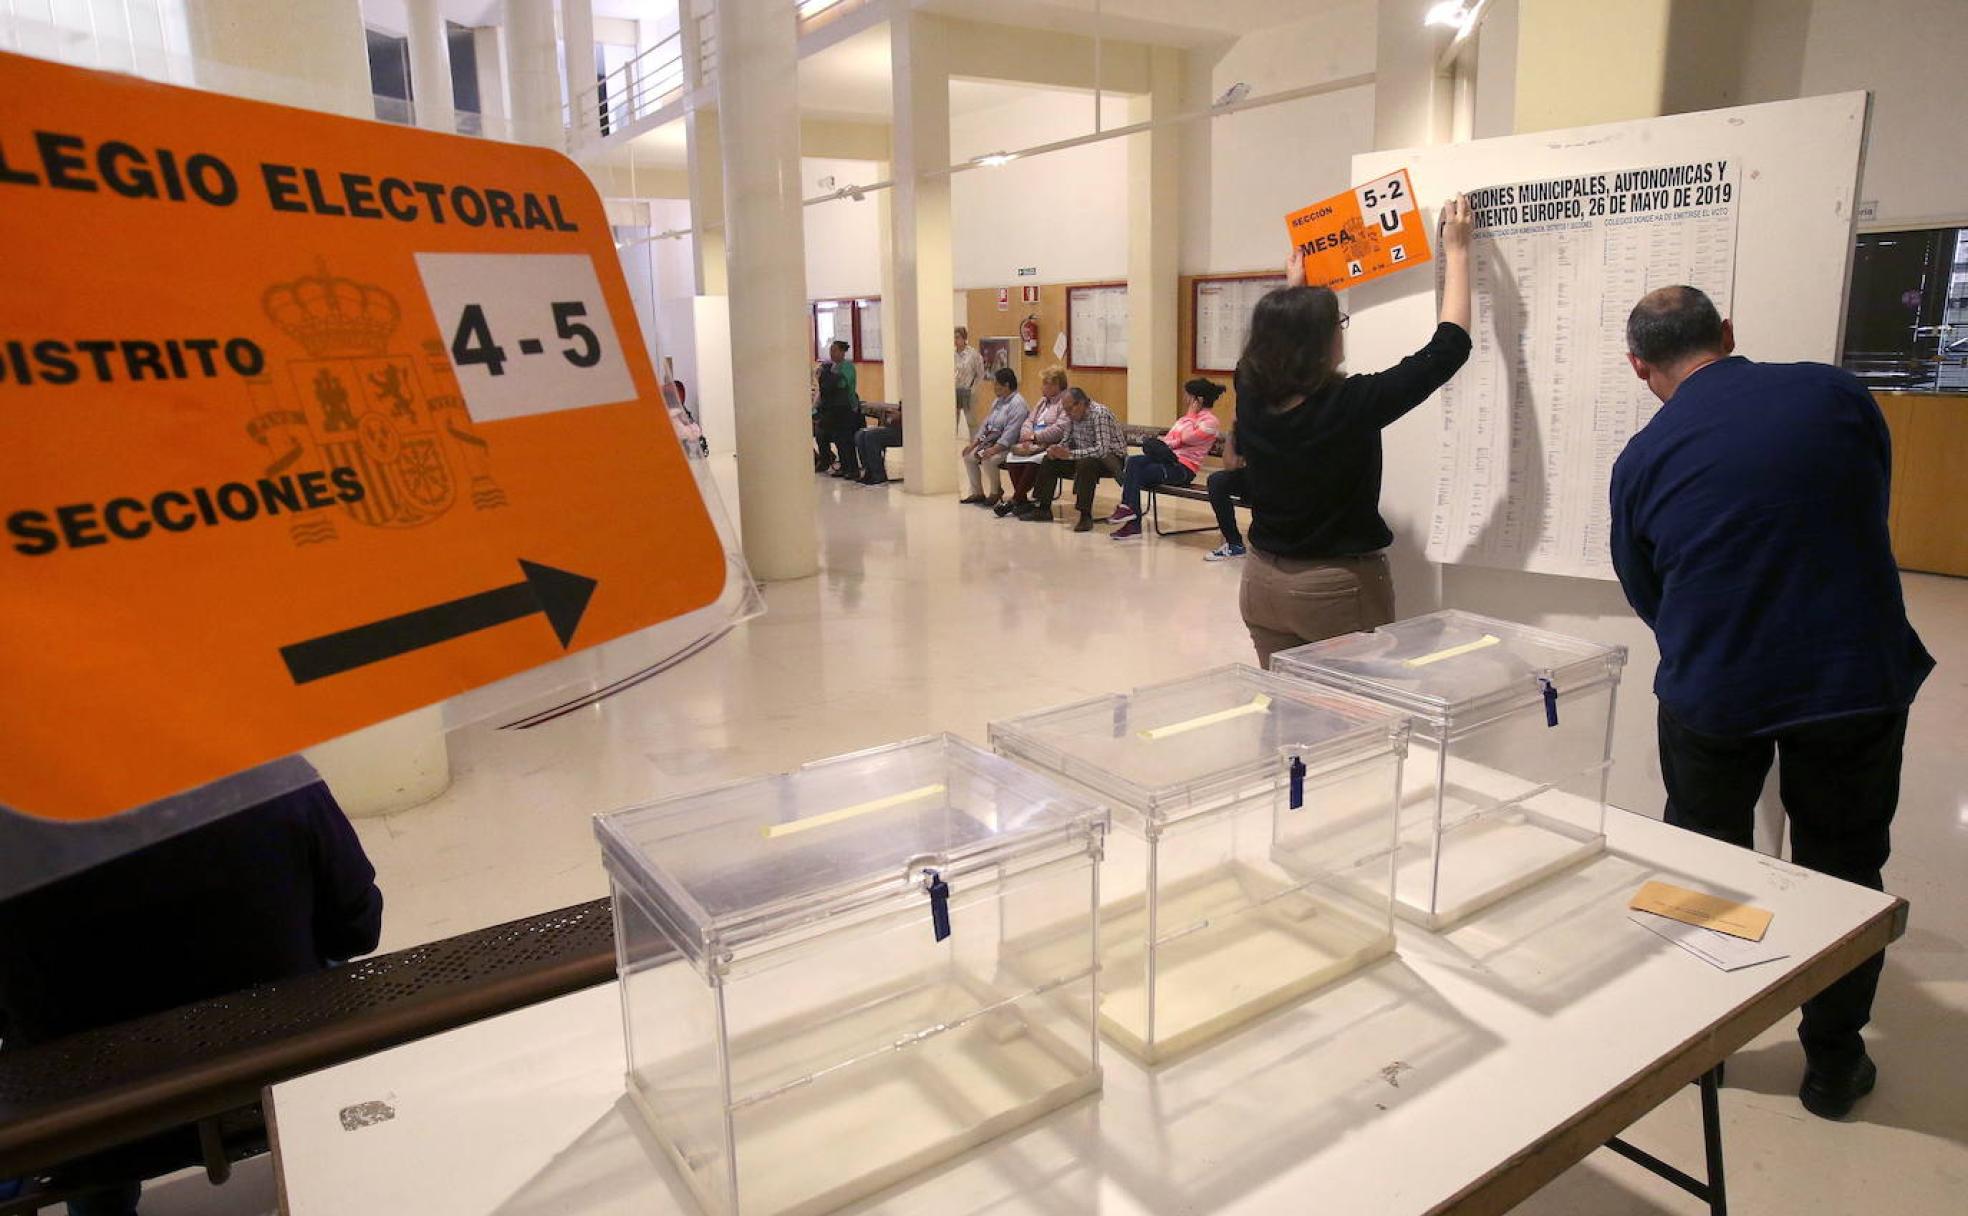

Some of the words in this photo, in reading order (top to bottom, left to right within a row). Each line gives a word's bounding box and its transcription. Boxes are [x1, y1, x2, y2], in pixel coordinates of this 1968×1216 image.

[0, 130, 238, 207] LEGIO
[260, 163, 578, 232] ELECTORAL
[1364, 180, 1404, 208] 5-2
[1467, 186, 1514, 211] CIONES
[1519, 175, 1609, 201] MUNICIPALES,
[1615, 162, 1712, 193] AUTONOMICAS
[1718, 161, 1727, 181] Y
[1380, 209, 1399, 231] U
[1522, 199, 1585, 222] EUROPEO,
[1589, 197, 1605, 216] 26
[1610, 194, 1626, 214] DE
[1631, 190, 1669, 213] MAYO
[1674, 188, 1690, 208] DE
[1695, 183, 1731, 206] 2019
[1299, 229, 1352, 257] MESA
[1352, 264, 1361, 275] A
[0, 337, 265, 386] ISTRITO
[6, 467, 365, 557] SECCIONES
